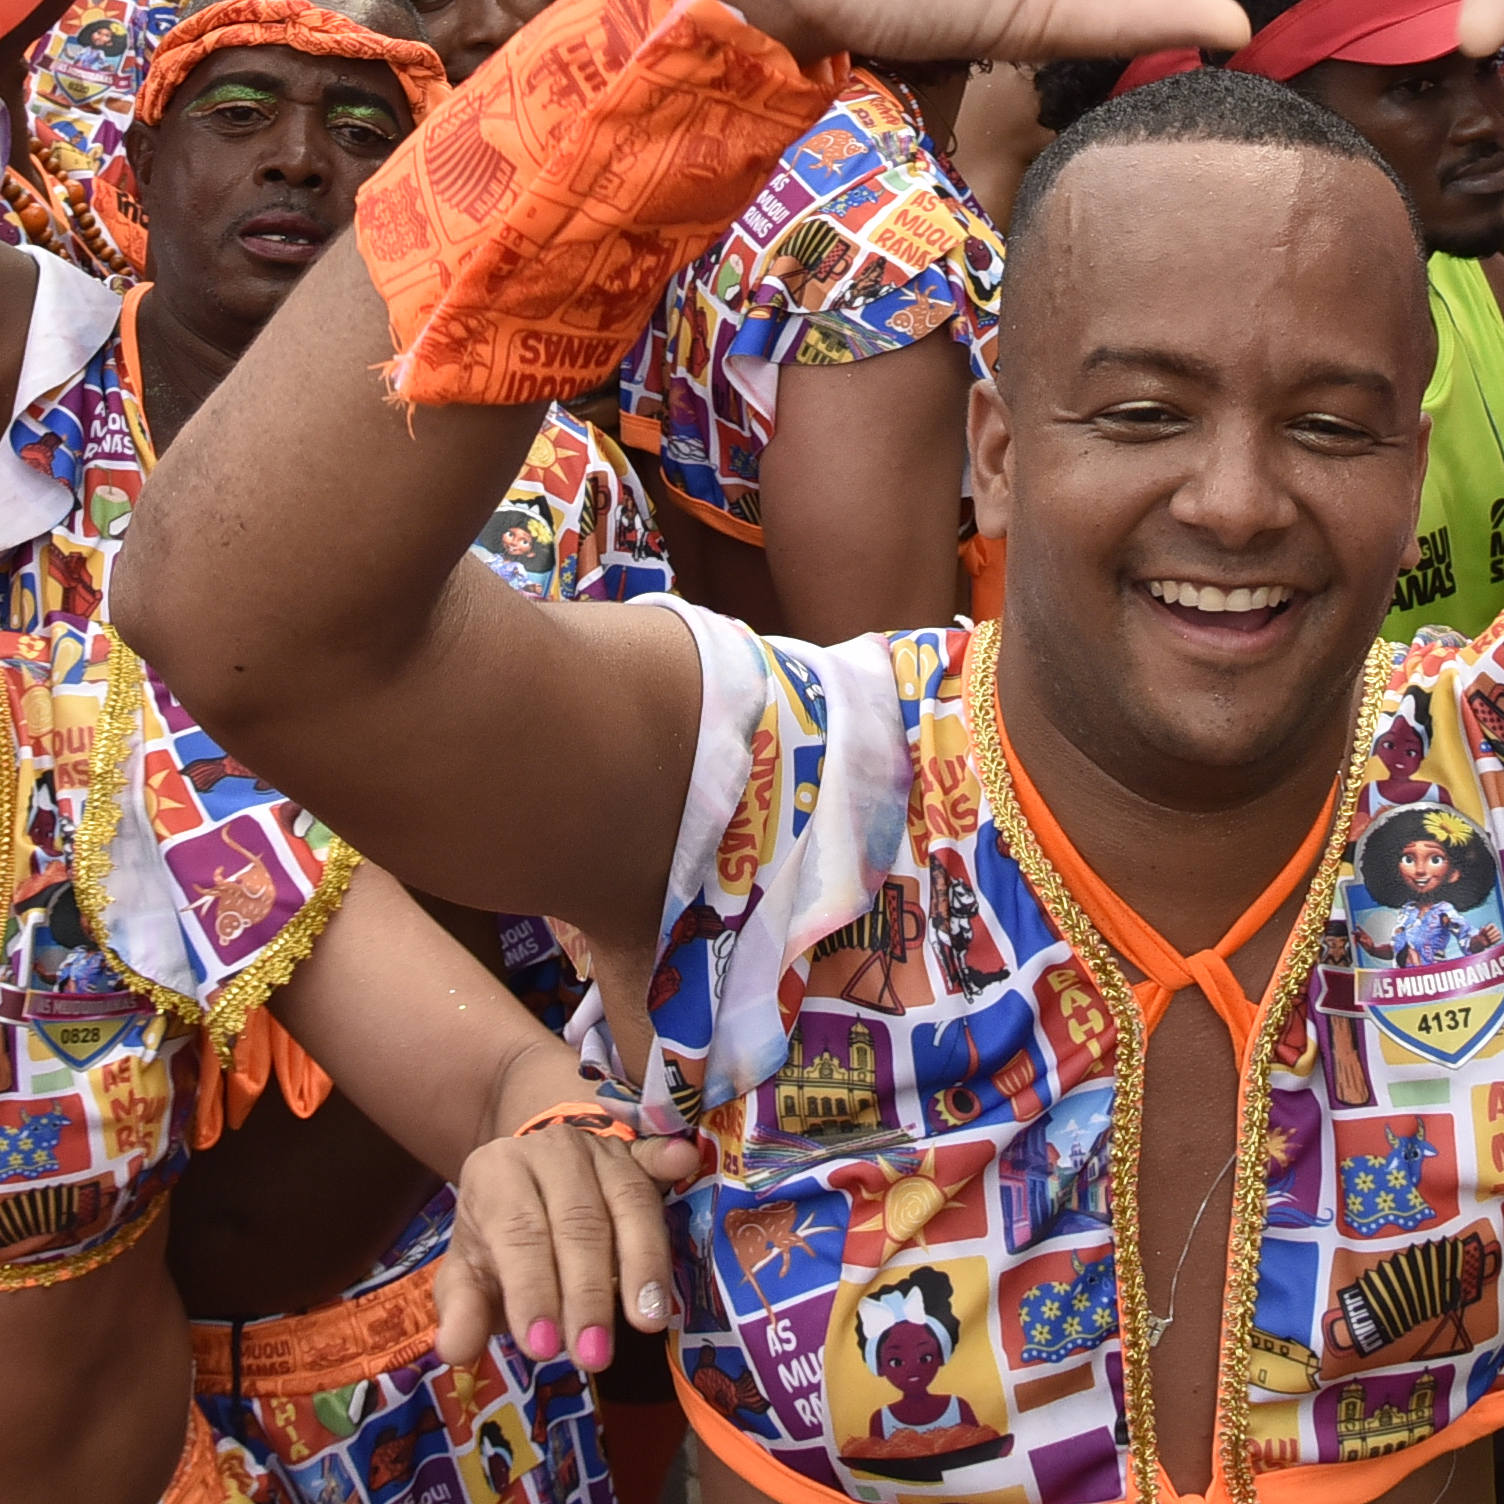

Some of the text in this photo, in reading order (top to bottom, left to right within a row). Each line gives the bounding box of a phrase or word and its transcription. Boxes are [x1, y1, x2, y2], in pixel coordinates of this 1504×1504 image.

[910, 192, 940, 214] AS
[1372, 975, 1395, 1000] AS
[1417, 1007, 1473, 1036] 4137
[59, 1025, 101, 1046] 0828
[765, 1318, 799, 1359] AS
